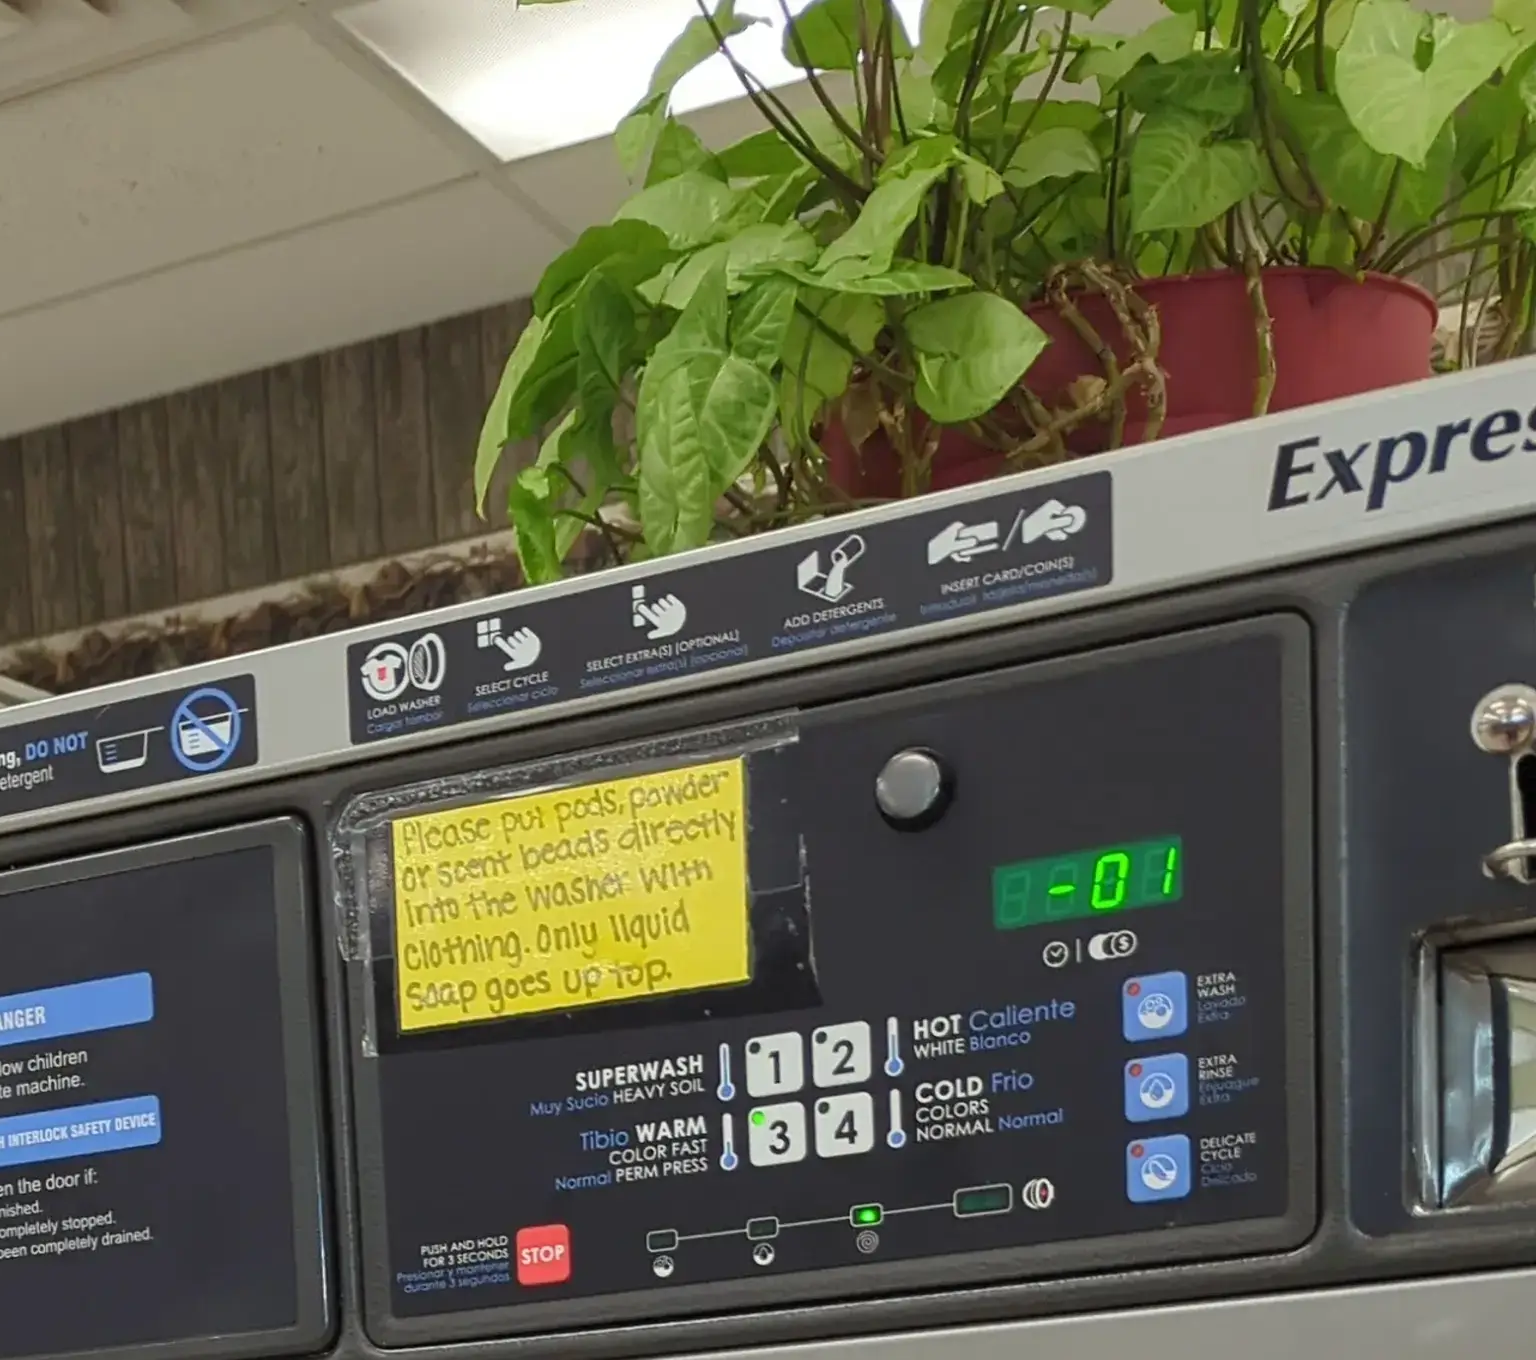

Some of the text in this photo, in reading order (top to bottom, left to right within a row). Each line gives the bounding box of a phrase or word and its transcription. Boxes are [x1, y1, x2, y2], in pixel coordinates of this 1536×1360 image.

[941, 577, 979, 595] INSERT
[784, 598, 885, 629] ADD DETERGENTS
[586, 655, 623, 672] SELECT
[476, 671, 548, 696] SELECT CYCLE
[367, 696, 441, 719] LOAD WASHER
[25, 742, 48, 761] DO
[54, 732, 89, 756] NOT
[402, 770, 729, 856] Please put pods, powder
[402, 809, 737, 892] or scent beads directly
[466, 887, 517, 921] the
[526, 871, 627, 910] washer
[641, 857, 714, 892] with
[609, 899, 690, 948] liquid
[406, 958, 671, 1014] soap goes up top.
[1197, 972, 1236, 987] EXTRA
[1197, 984, 1235, 998] WASH
[914, 999, 1075, 1041] HOT Caliente
[831, 1040, 854, 1076] 2
[914, 1030, 1031, 1059] WHITE Blanco
[27, 1051, 88, 1072] children
[576, 1054, 703, 1091] SUPERWASH
[769, 1051, 780, 1084] 1
[1199, 1055, 1237, 1068] EXTRA
[1199, 1066, 1233, 1080] RINSE
[16, 1073, 85, 1096] machine.
[530, 1078, 705, 1116] Muy Sucio HEAVY SOIL
[915, 1073, 1034, 1103] COLD Frio
[915, 1099, 989, 1123] COLORS
[916, 1108, 1063, 1141] NORMAL Normal
[8, 1126, 68, 1147] INTERLOCK
[70, 1119, 111, 1138] SAFETY
[114, 1112, 156, 1131] DEVICE
[580, 1115, 707, 1151] Tibio WARM
[768, 1120, 790, 1154] 3
[835, 1110, 858, 1145] 4
[1200, 1133, 1256, 1149] DELICATE
[609, 1137, 708, 1166] COLOR FAST
[1201, 1147, 1242, 1162] CYCLE
[18, 1178, 41, 1194] the
[45, 1172, 80, 1190] door
[84, 1169, 98, 1184] if:
[556, 1157, 708, 1190] Normal PERM PRESS
[62, 1211, 116, 1232] stopped.
[30, 1235, 98, 1256] completely
[102, 1227, 153, 1246] drained.
[522, 1245, 564, 1264] STOP
